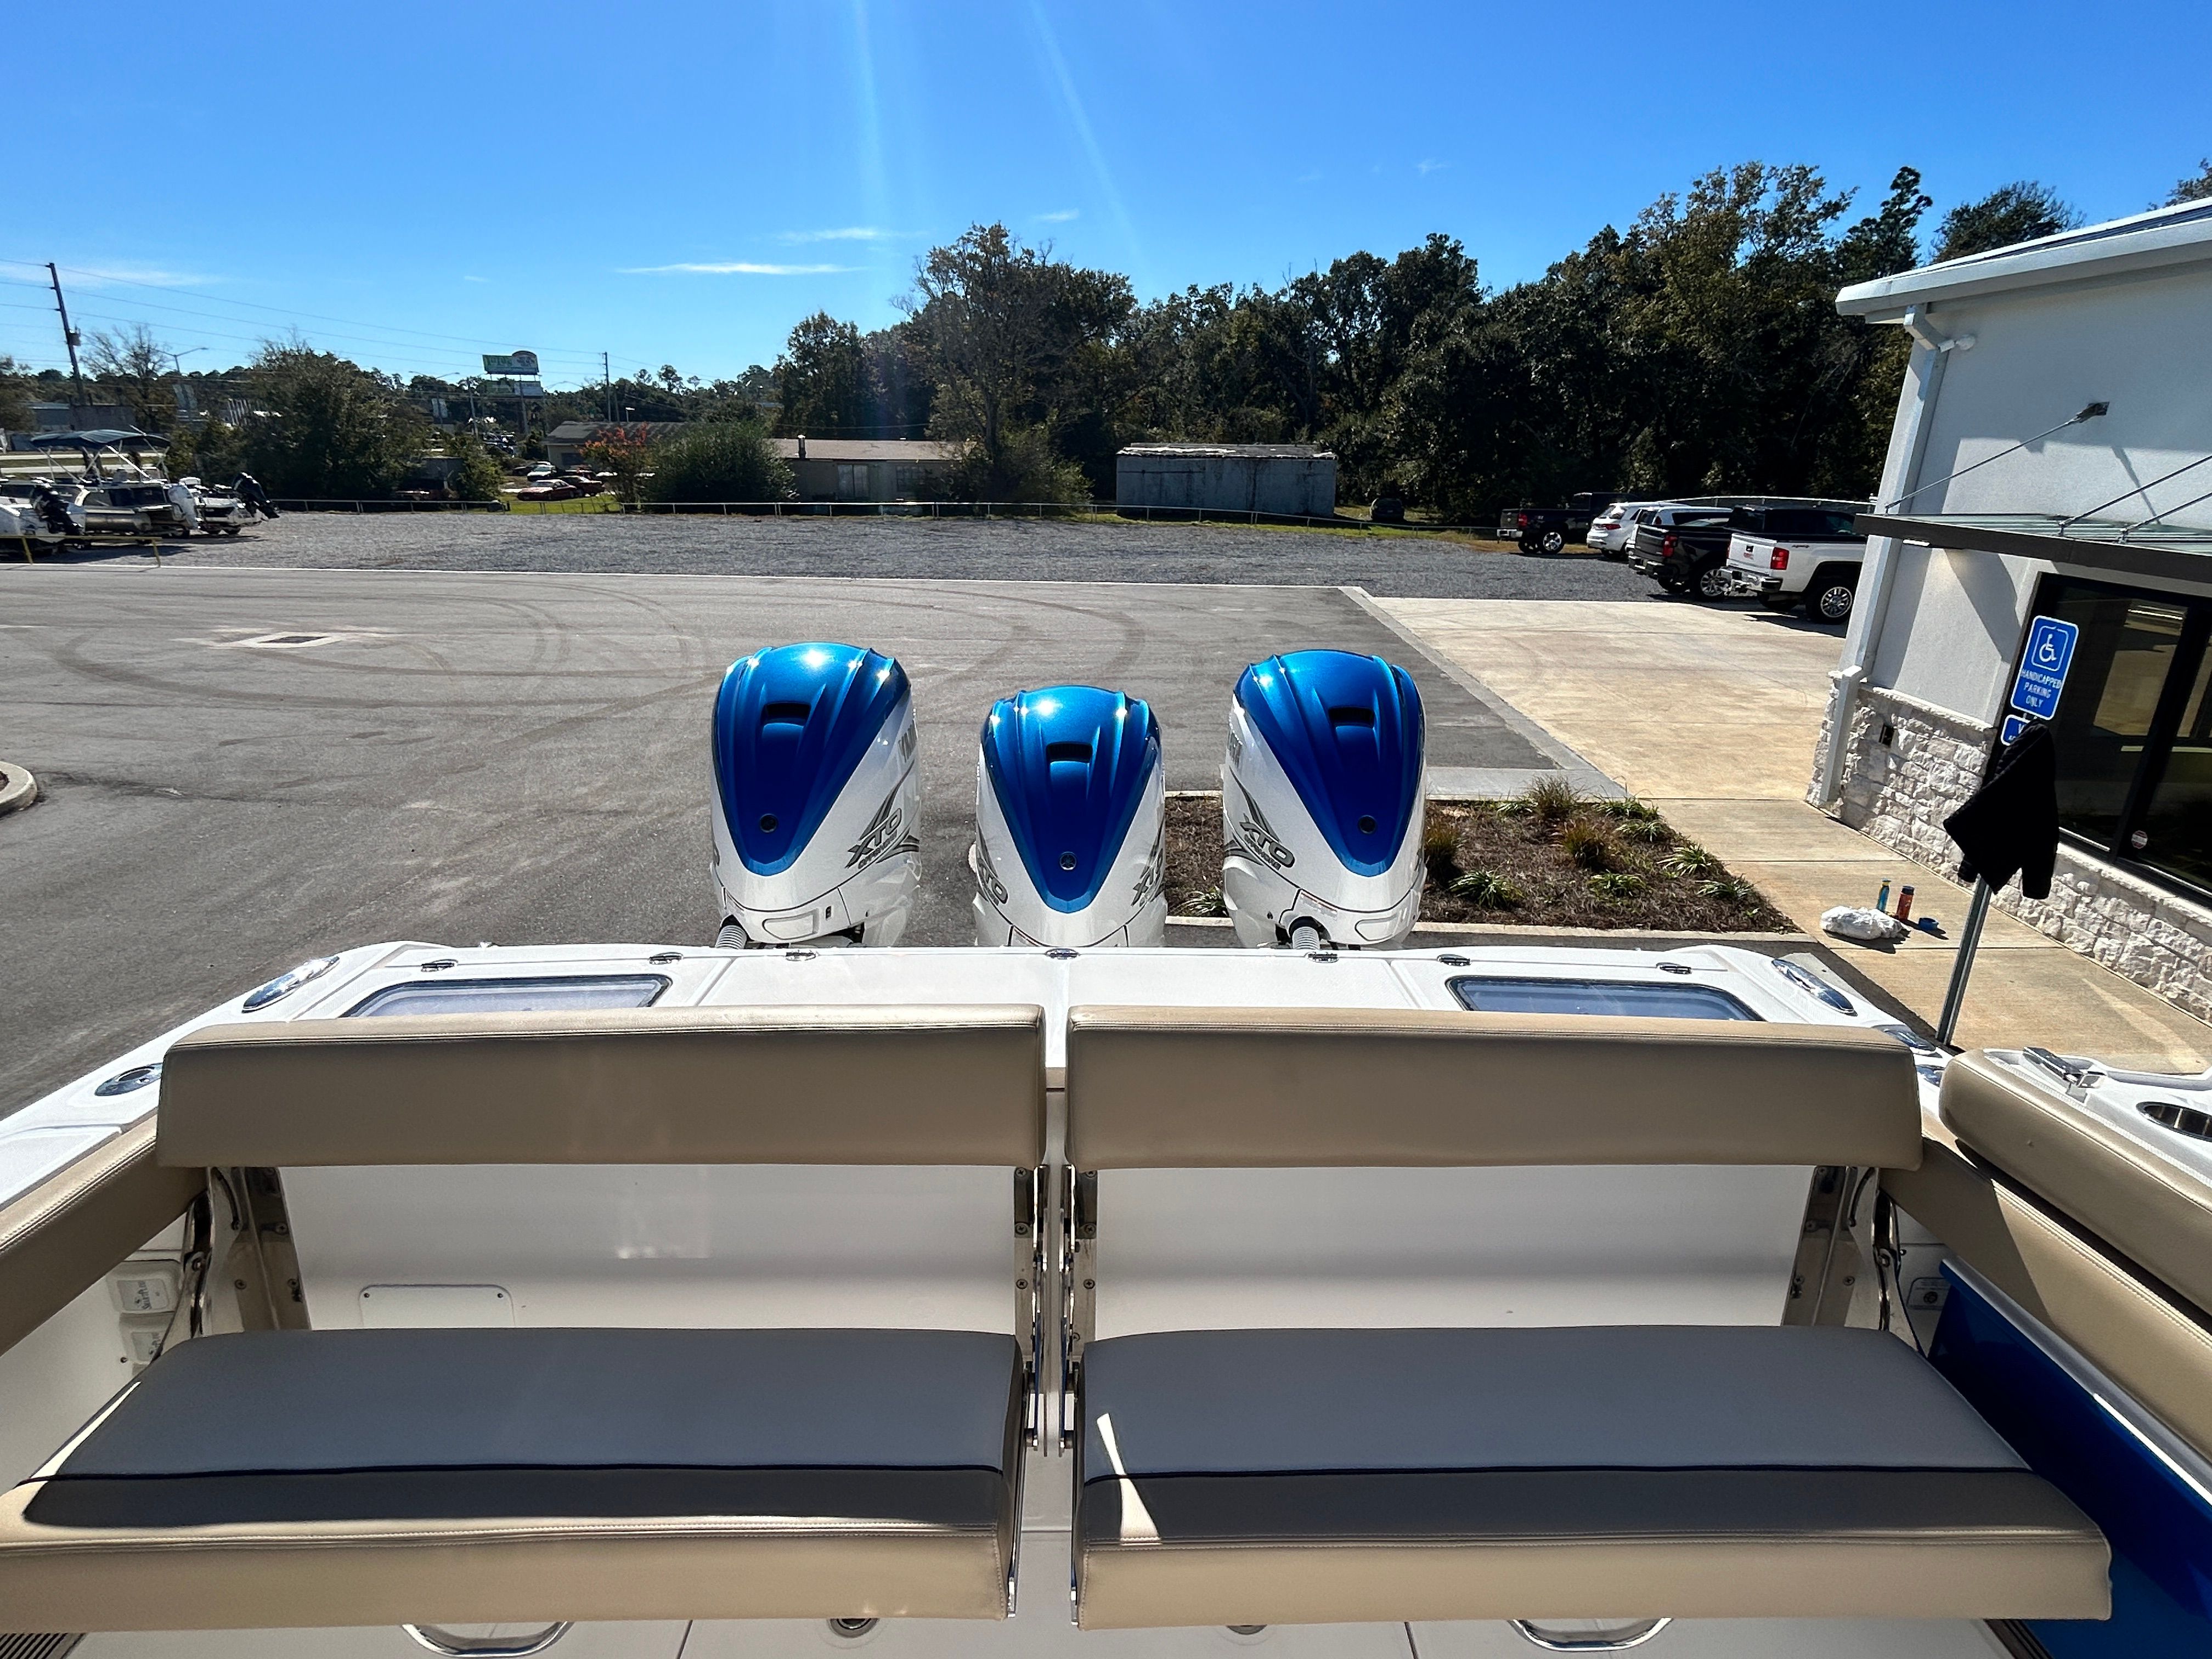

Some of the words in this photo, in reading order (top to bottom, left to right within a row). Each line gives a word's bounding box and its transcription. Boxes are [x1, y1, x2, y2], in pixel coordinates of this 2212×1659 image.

[2020, 668, 2063, 689] HANDICAPPED
[2023, 681, 2052, 699] PARKING
[2025, 695, 2044, 708] ONLY
[844, 808, 902, 869] XTO
[1239, 812, 1296, 868] XTO
